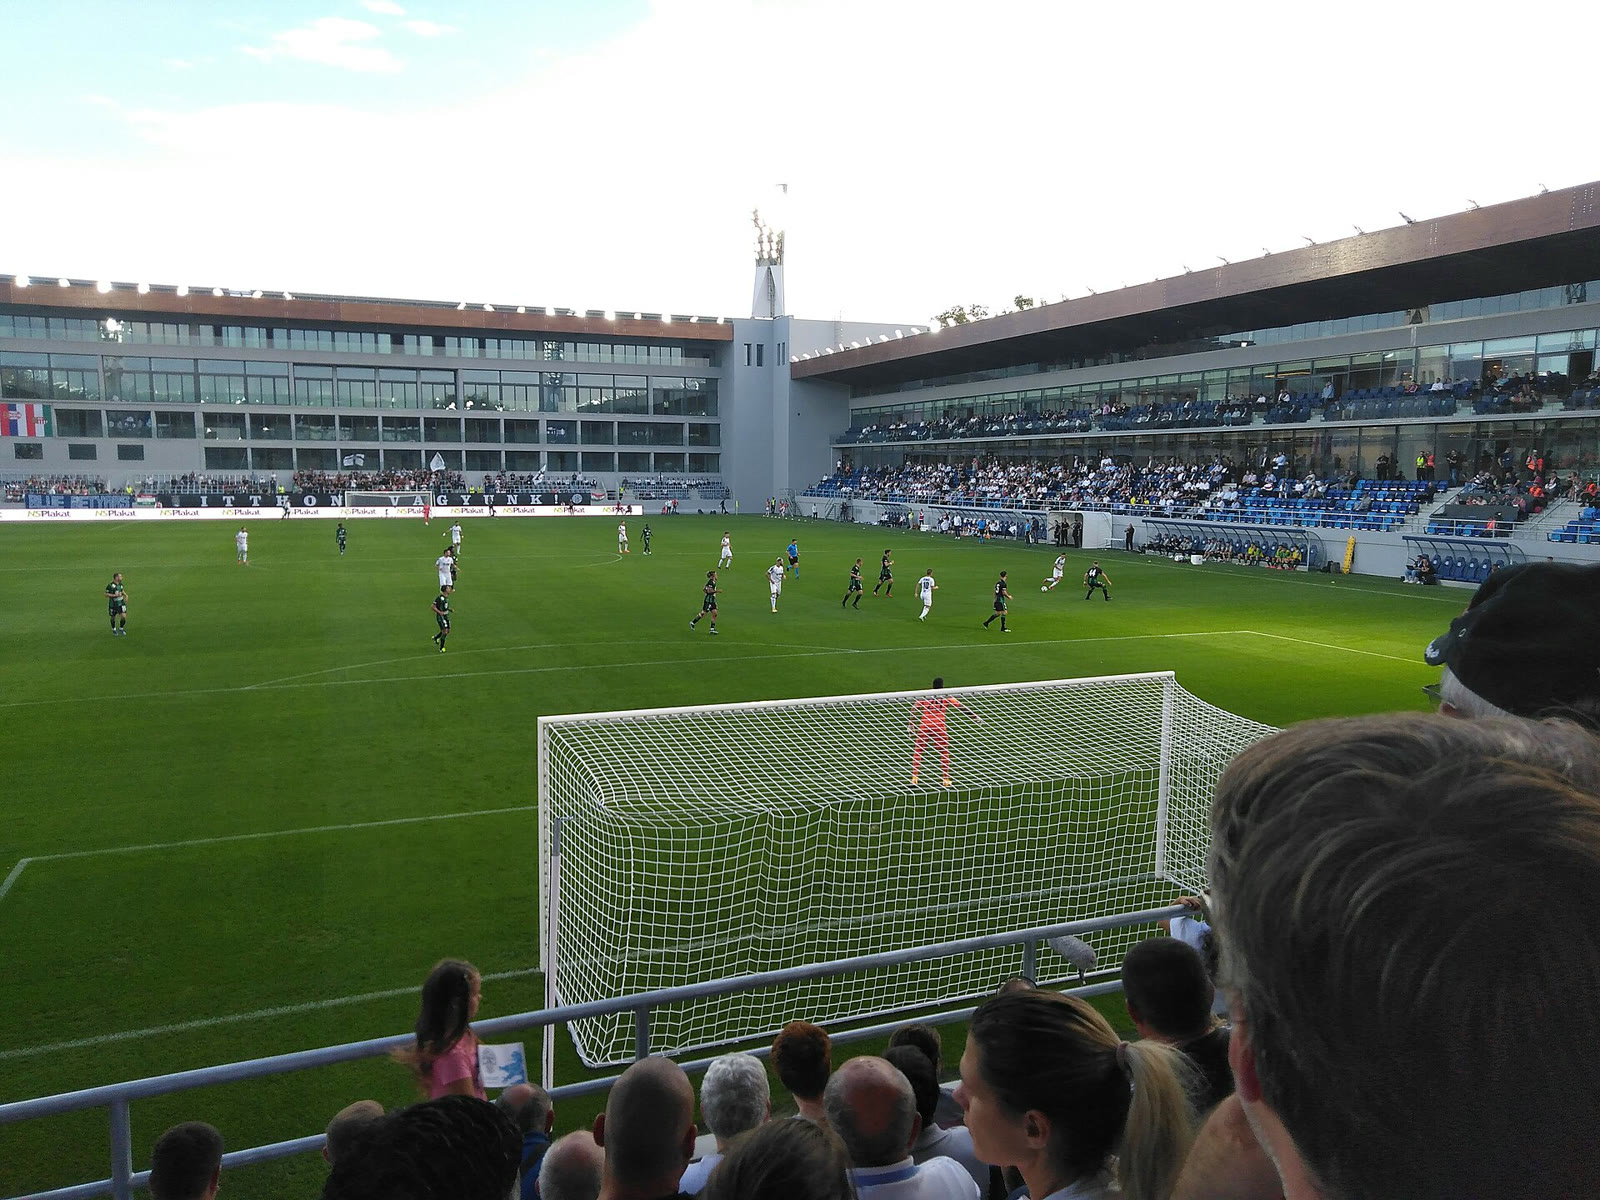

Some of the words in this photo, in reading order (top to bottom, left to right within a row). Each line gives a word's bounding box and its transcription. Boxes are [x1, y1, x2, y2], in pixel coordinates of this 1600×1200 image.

[28, 494, 64, 508] BLUE
[200, 494, 343, 507] ITTHON
[1089, 568, 1097, 577] 44
